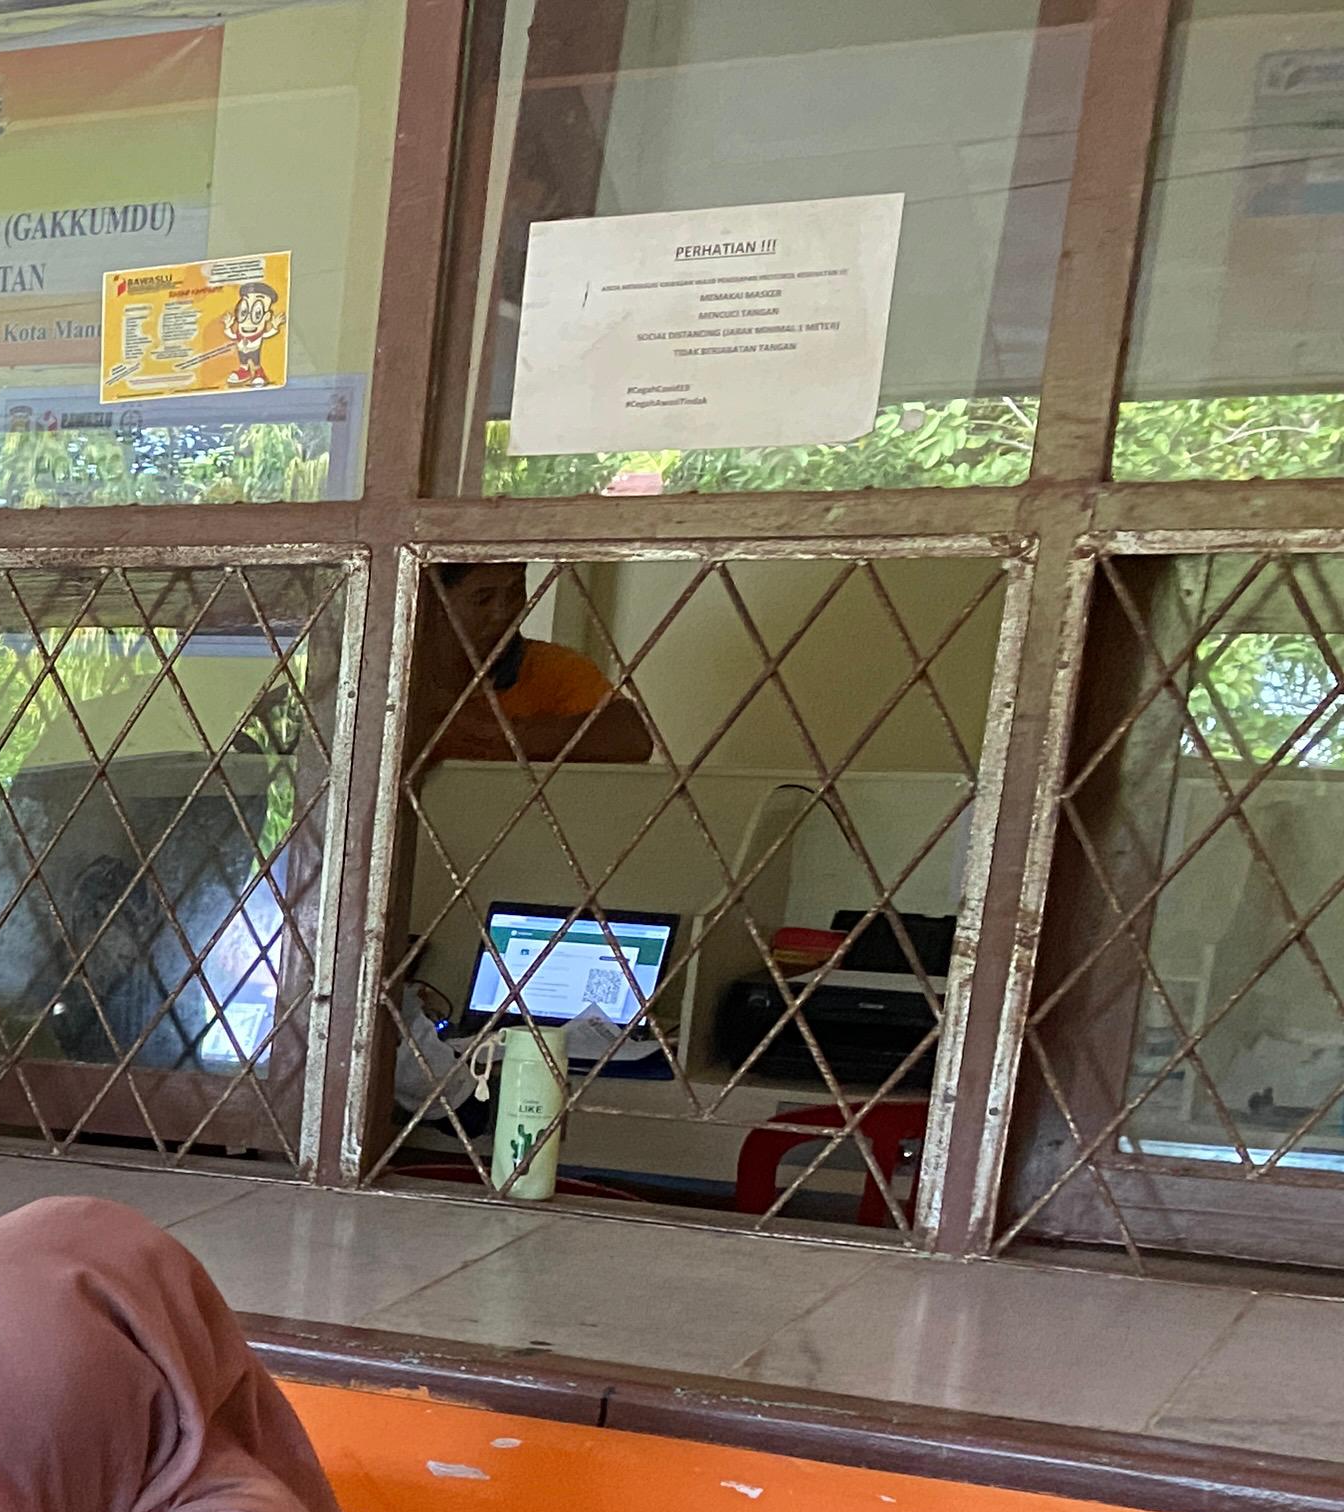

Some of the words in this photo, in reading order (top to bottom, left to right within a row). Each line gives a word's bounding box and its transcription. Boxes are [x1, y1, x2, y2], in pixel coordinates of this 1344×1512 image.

[5, 202, 175, 248] (GAKKUMDU)
[675, 241, 757, 260] PERHATIAN
[761, 239, 777, 253] !!!
[4, 322, 47, 342] Kota
[518, 1104, 544, 1114] LIKE
